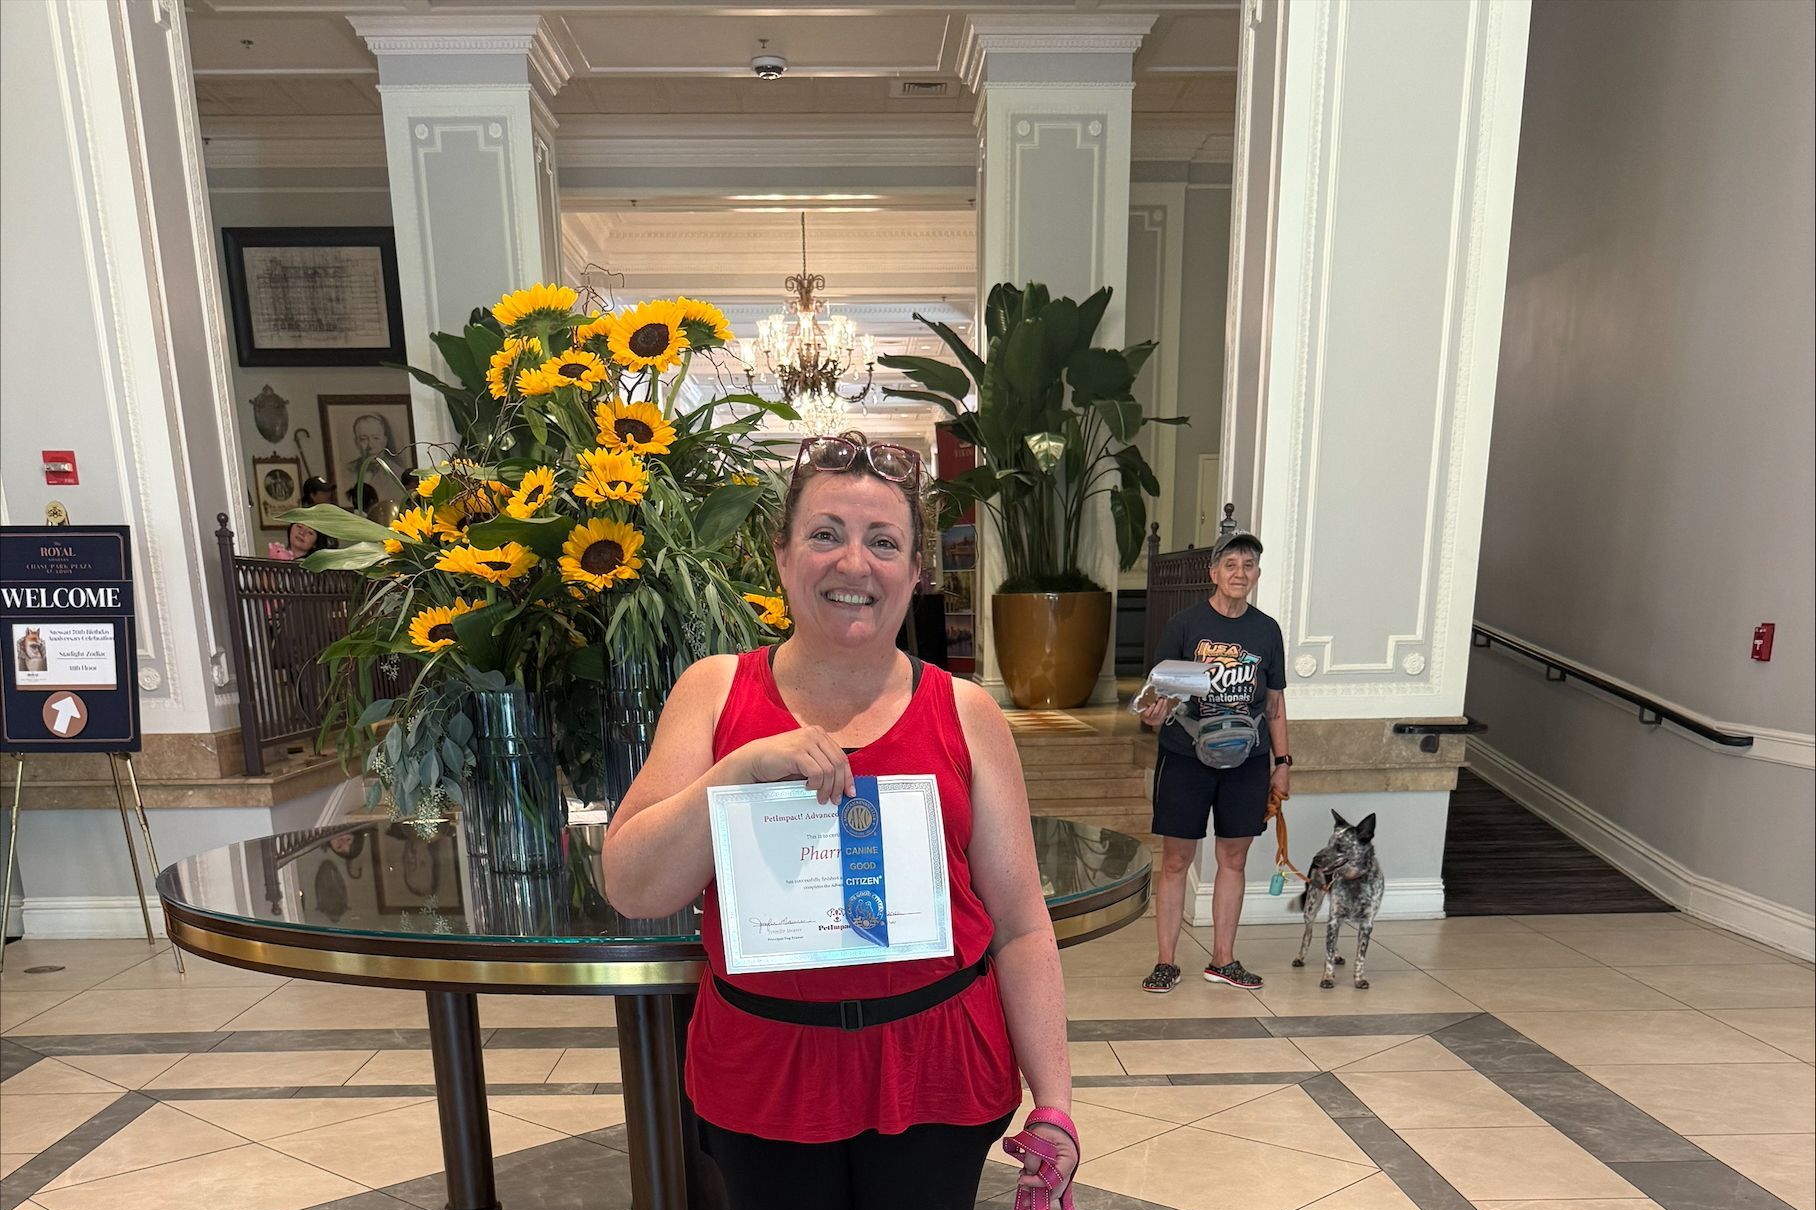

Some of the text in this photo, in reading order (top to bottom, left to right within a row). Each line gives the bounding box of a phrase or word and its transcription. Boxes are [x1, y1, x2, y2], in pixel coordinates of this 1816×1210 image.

[40, 547, 76, 557] ROYAL
[1, 587, 121, 609] WELCOME
[1209, 662, 1255, 693] Raw
[764, 813, 803, 823] PetImpact!
[845, 846, 879, 856] CANINE
[850, 862, 876, 870] GOOD
